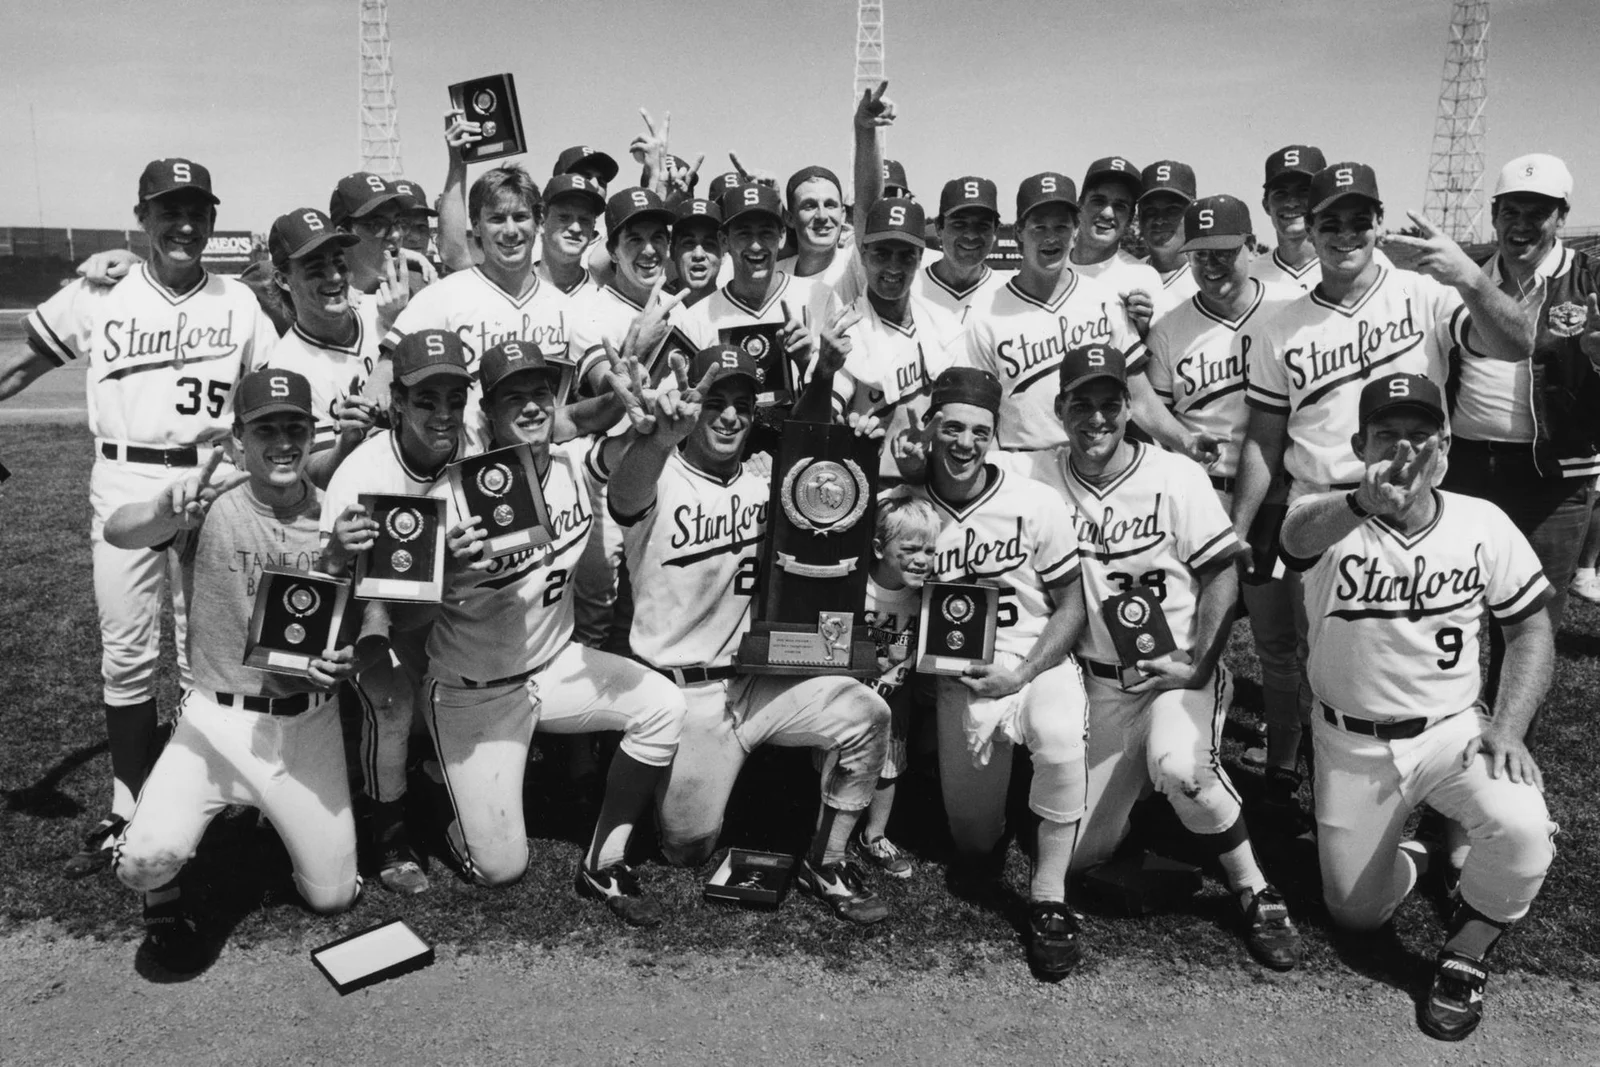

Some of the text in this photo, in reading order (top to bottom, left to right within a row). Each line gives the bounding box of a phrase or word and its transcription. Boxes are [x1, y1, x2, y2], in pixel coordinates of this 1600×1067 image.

[1111, 159, 1126, 172] S
[1284, 151, 1300, 167] S
[173, 163, 191, 183] S
[725, 174, 739, 188] S
[1157, 166, 1171, 181] S
[1335, 169, 1354, 187] S
[1525, 167, 1534, 177] S
[366, 175, 386, 193] S
[572, 175, 586, 189] S
[964, 182, 979, 198] S
[1041, 177, 1056, 193] S
[631, 191, 649, 208] S
[743, 188, 759, 206] S
[692, 201, 707, 215] S
[888, 206, 906, 226] S
[303, 211, 324, 231] S
[1198, 210, 1214, 229] S
[104, 310, 237, 362] Stanford
[998, 302, 1111, 379] Stanford
[1285, 298, 1423, 390] Stanford
[426, 335, 445, 356] S
[504, 343, 523, 361] S
[722, 351, 739, 368] S
[1088, 349, 1105, 367] S
[270, 376, 289, 397] S
[1388, 378, 1410, 398] S
[175, 377, 232, 418] 35
[671, 494, 770, 549] Stanfor
[1070, 493, 1166, 556] tanford
[1337, 543, 1485, 611] Stanford
[1435, 627, 1463, 670] 9
